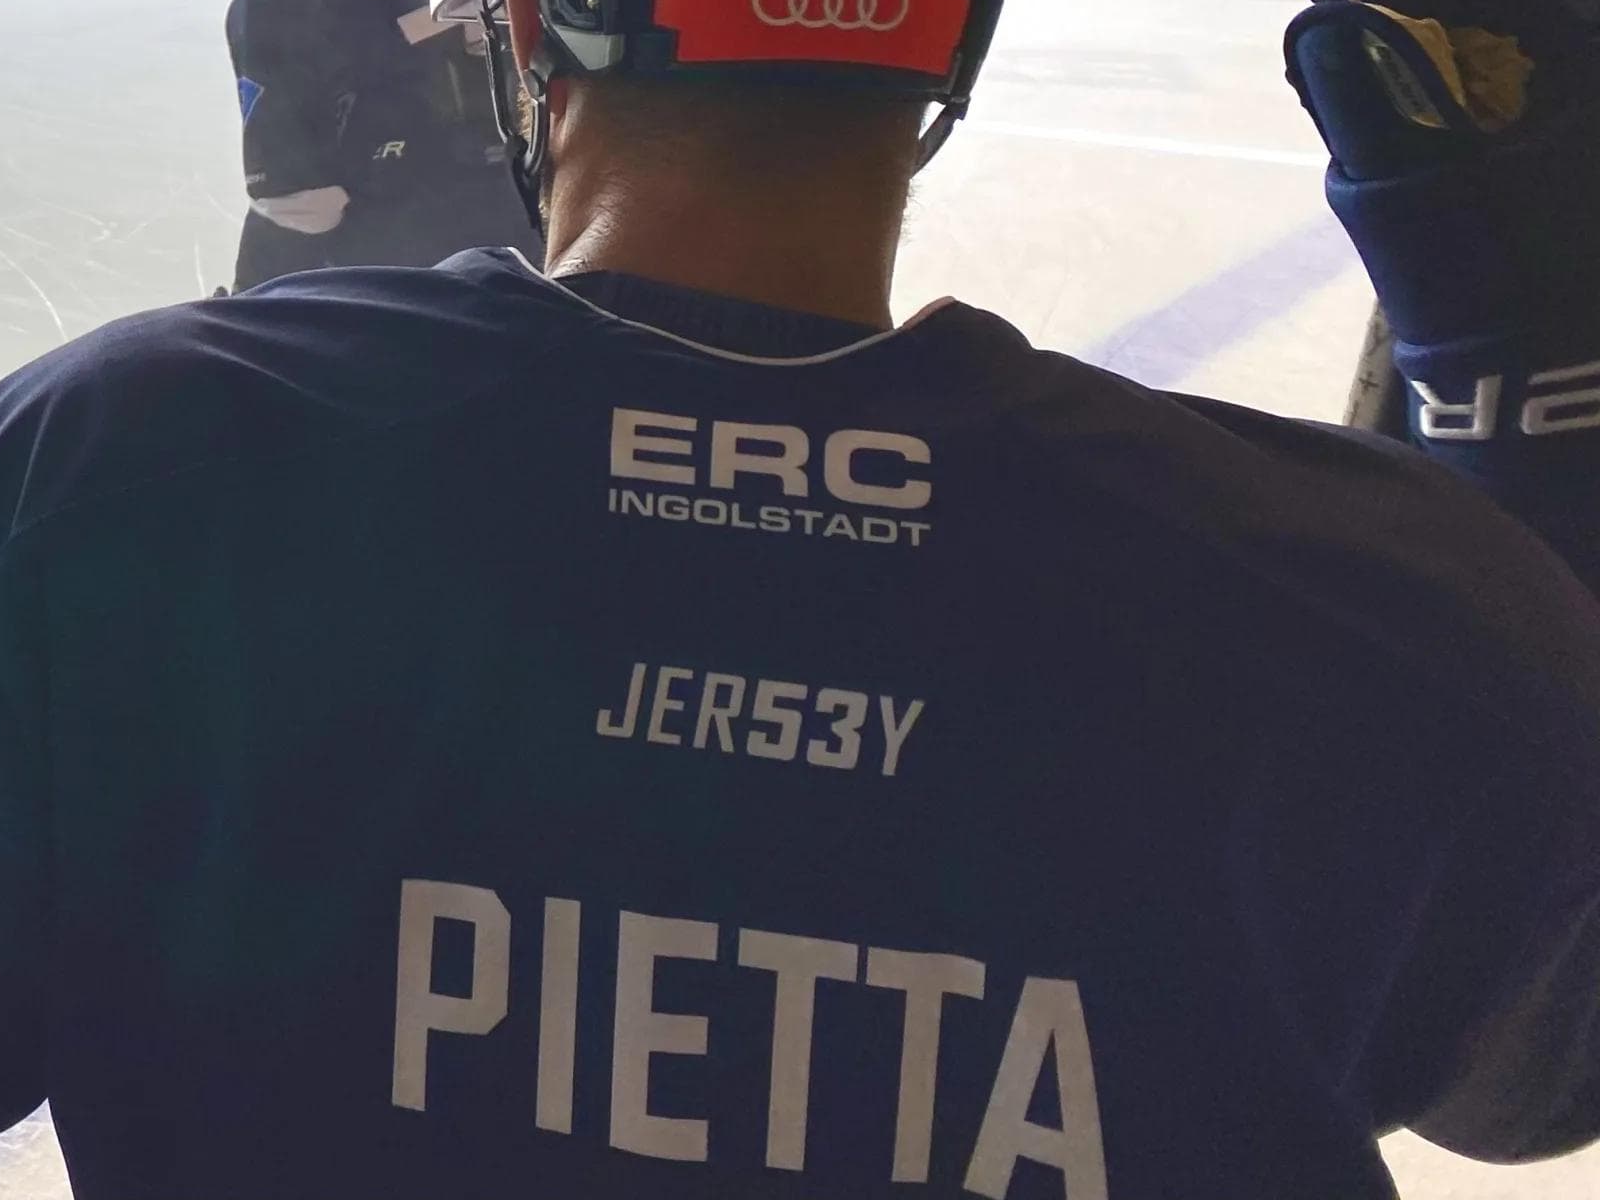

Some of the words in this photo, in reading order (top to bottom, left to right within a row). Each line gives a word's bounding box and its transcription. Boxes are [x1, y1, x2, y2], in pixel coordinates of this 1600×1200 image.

[609, 406, 933, 511] ERC
[607, 488, 932, 548] INGOLSTADT
[390, 877, 1110, 1200] PIETTA
